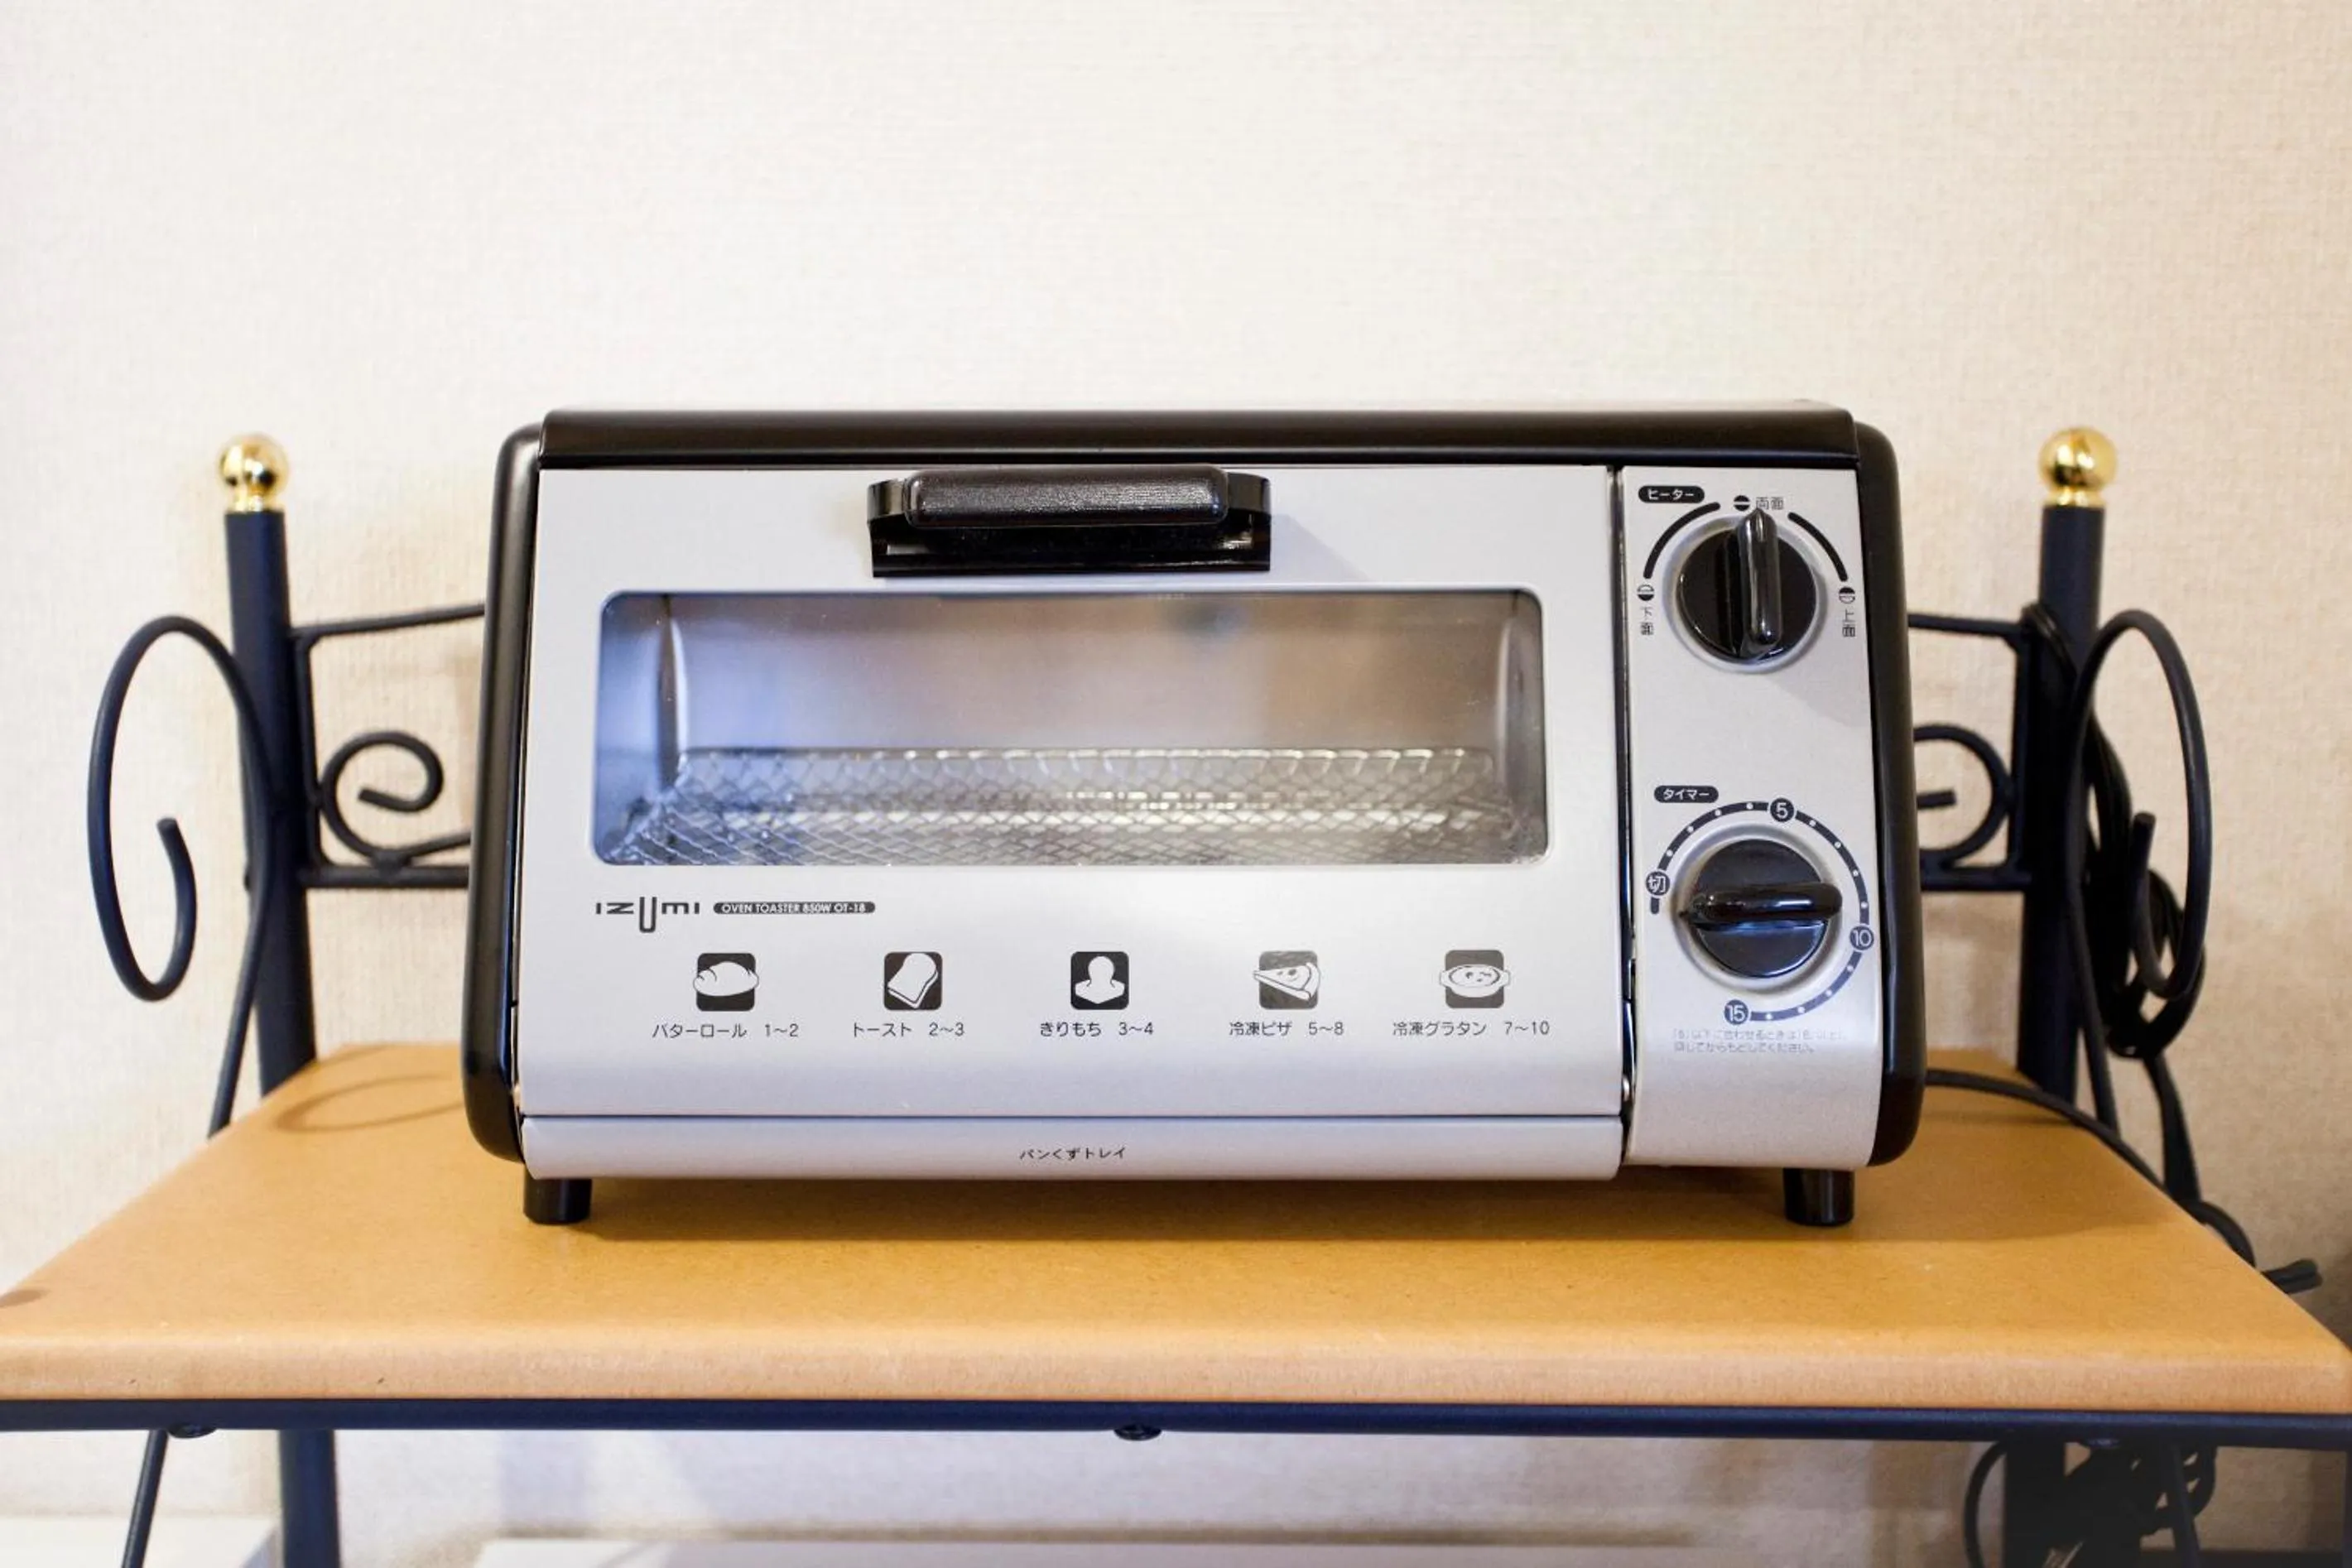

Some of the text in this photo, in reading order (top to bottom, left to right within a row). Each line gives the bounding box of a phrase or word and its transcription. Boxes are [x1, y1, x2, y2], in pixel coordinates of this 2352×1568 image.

[1647, 488, 1695, 500] ヒーター
[1662, 787, 1710, 801] タイマー
[1776, 802, 1788, 819] 5
[1647, 874, 1666, 892] 切
[722, 903, 753, 913] OVEN
[755, 903, 801, 913] TOASTER
[1853, 929, 1872, 946] 10
[1728, 1004, 1746, 1022] 15
[652, 1023, 747, 1038] バターロール
[854, 1022, 911, 1037] トースト
[1040, 1022, 1101, 1037] きりもち
[1229, 1021, 1292, 1036] 冷凍ピザ
[1393, 1021, 1487, 1036] 冷凍グラタン
[1019, 1147, 1126, 1161] パンくずトレイ
